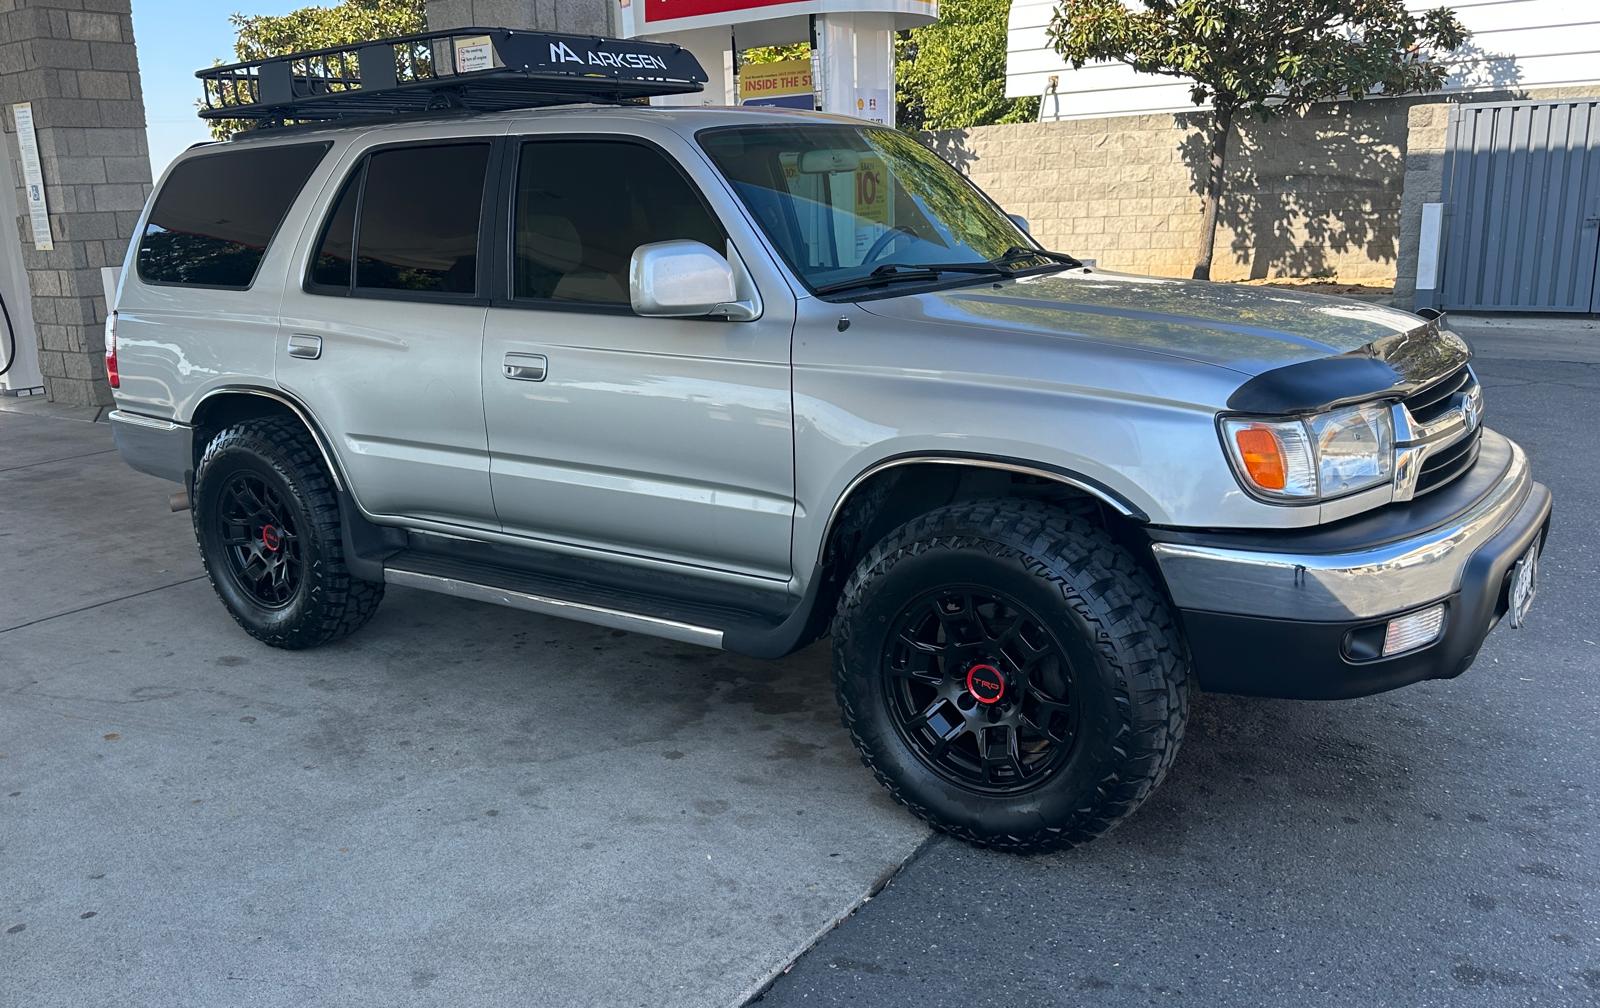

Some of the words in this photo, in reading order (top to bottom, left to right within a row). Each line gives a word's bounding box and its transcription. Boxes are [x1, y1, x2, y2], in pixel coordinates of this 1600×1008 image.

[588, 50, 667, 70] ARKSEN
[745, 79, 777, 92] INSIDE
[780, 76, 799, 88] THE
[973, 677, 999, 690] TRD
